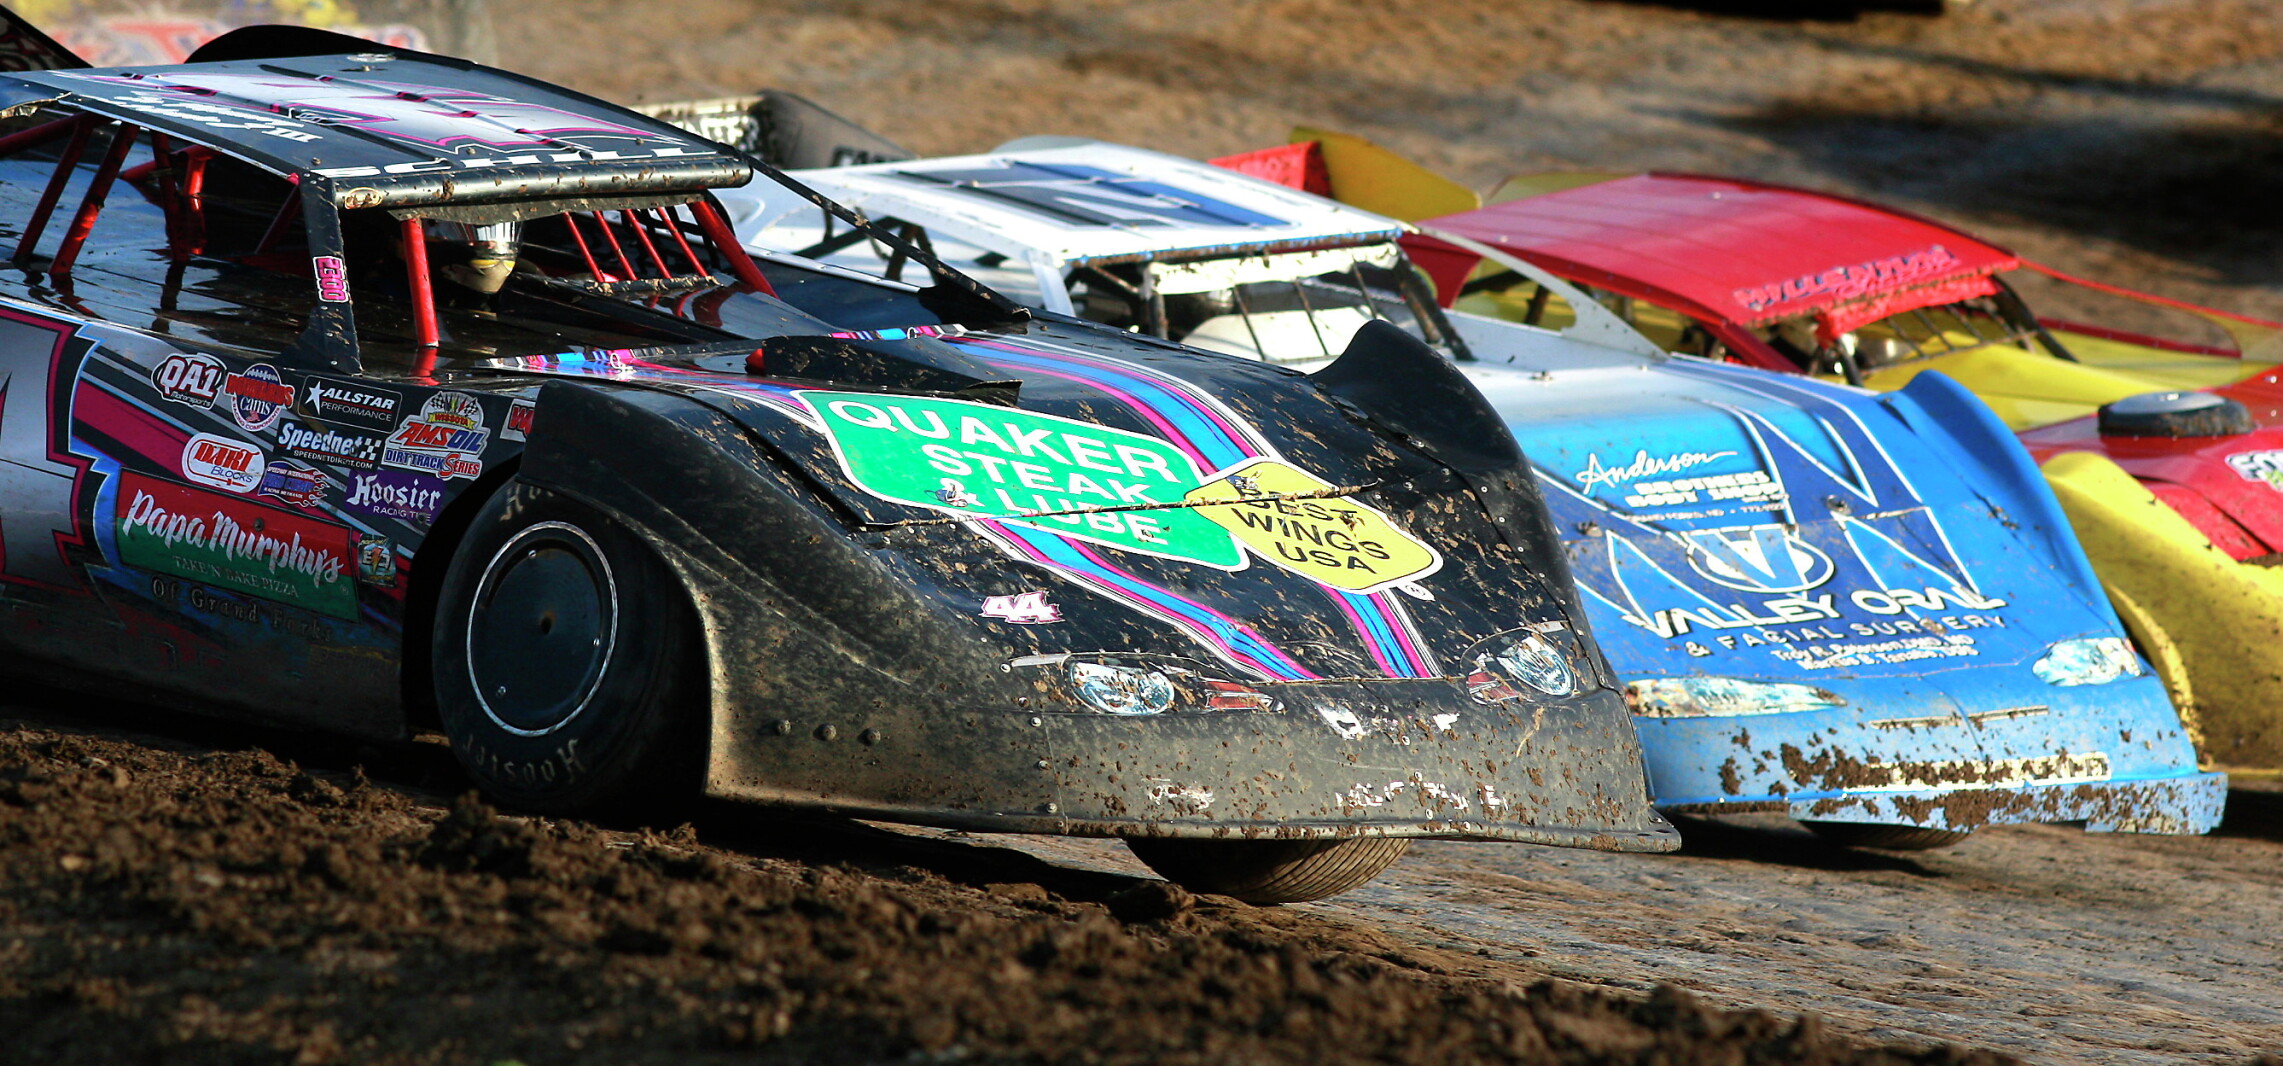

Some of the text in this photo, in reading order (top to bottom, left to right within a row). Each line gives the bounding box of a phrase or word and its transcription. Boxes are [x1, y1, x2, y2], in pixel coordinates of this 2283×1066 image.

[315, 257, 348, 302] 2300
[160, 357, 220, 398] QA1
[171, 391, 211, 406] Motorsports
[321, 401, 392, 421] PERFORMANCE
[323, 388, 395, 409] ALLSTAR
[278, 422, 363, 457] Speednet
[396, 422, 485, 452] AMSOIL
[827, 400, 1182, 484] QUAKER
[194, 442, 260, 471] DART
[211, 465, 253, 483] BLOCKS
[386, 449, 480, 476] DIRT TRACK SERIES
[1576, 450, 1738, 495] Anderson
[346, 474, 441, 511] Hoosier
[922, 444, 1171, 513] STEAK
[1625, 491, 1698, 507] BODY
[1708, 483, 1780, 500] SHOP
[1634, 471, 1771, 494] BROTHERS
[373, 505, 407, 518] RACING
[994, 487, 1168, 546] LUBE
[1241, 489, 1359, 527] BEST
[122, 489, 344, 588] Papa Murphy's
[1231, 507, 1390, 560] WINGS
[1275, 541, 1377, 574] USA
[173, 556, 205, 573] TAKE
[226, 568, 258, 587] BAKE
[260, 575, 299, 597] PIZZA
[191, 588, 259, 623] Grand
[982, 592, 1062, 624] 44
[1623, 586, 2006, 640] VALLEY ORAL
[1716, 626, 1845, 650] FACIAL
